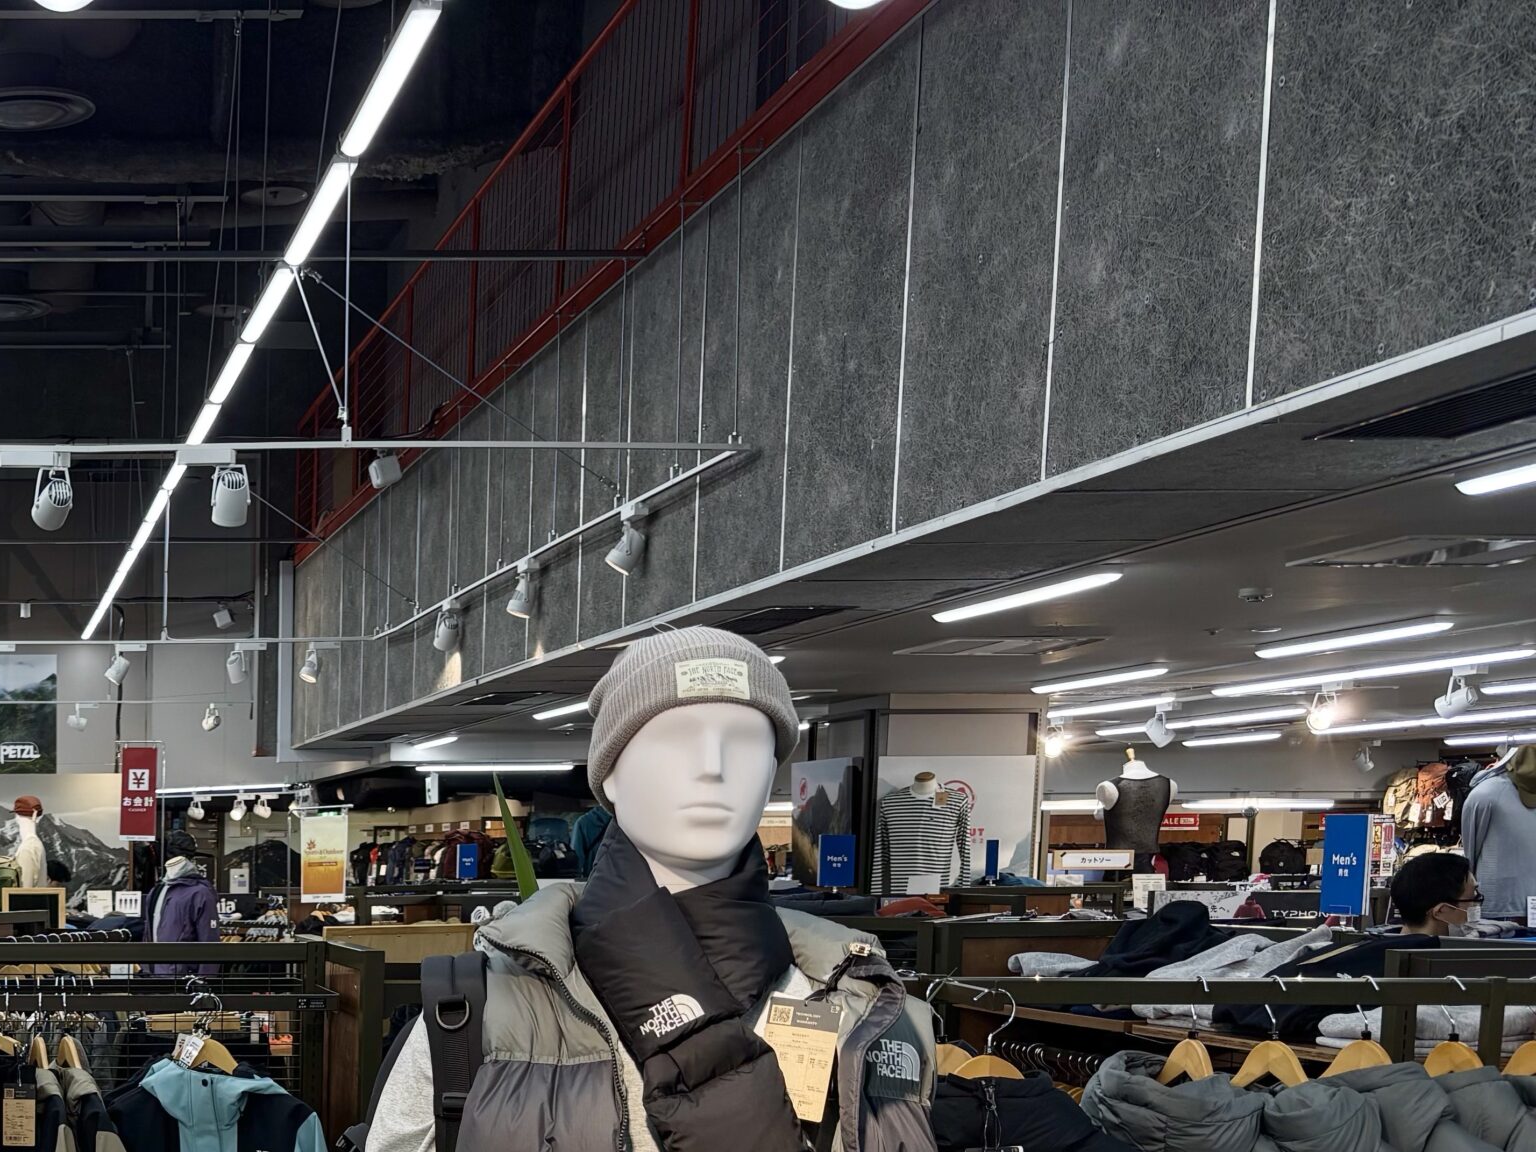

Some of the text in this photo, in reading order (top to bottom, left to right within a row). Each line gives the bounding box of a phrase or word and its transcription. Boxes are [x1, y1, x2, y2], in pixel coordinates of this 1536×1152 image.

[0, 745, 41, 764] PETZL
[132, 772, 146, 788] ¥
[122, 796, 154, 807] お会計
[827, 854, 848, 862] Men's
[1080, 856, 1112, 864] カットソー
[1332, 853, 1357, 865] Men's
[649, 997, 672, 1017] THE
[639, 1006, 680, 1035] NORTH
[654, 1015, 684, 1038] FACE
[880, 1038, 902, 1053] THE
[866, 1050, 902, 1066] NORTH
[877, 1063, 902, 1079] FACE
